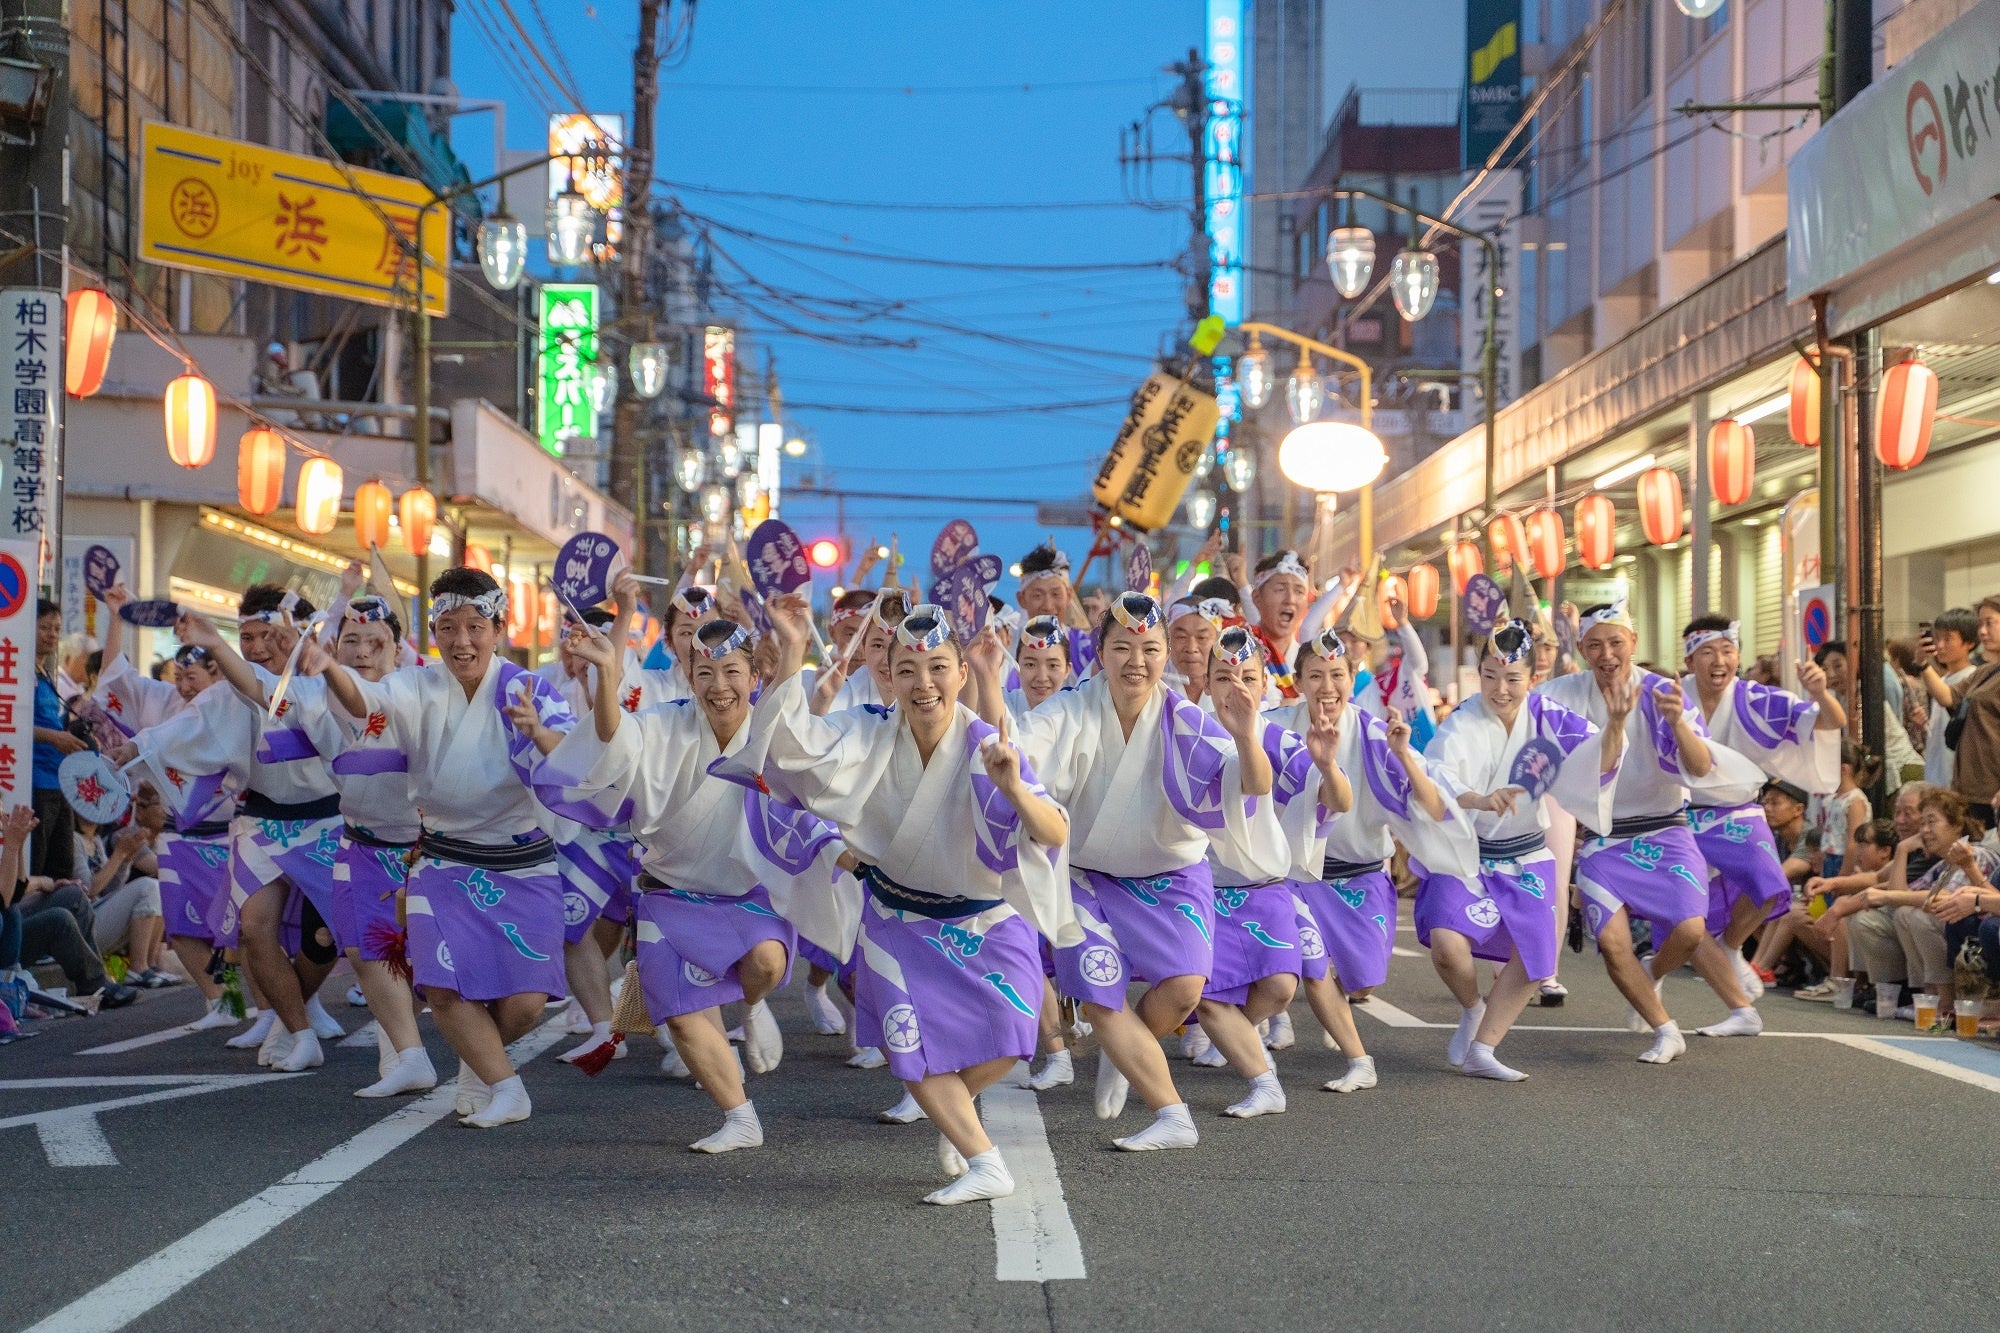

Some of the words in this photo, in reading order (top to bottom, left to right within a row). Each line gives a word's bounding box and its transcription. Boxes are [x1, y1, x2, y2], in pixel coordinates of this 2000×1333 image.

[1470, 84, 1520, 103] SMBC
[227, 151, 264, 185] joy
[12, 298, 47, 533] 柏木学園高等学校
